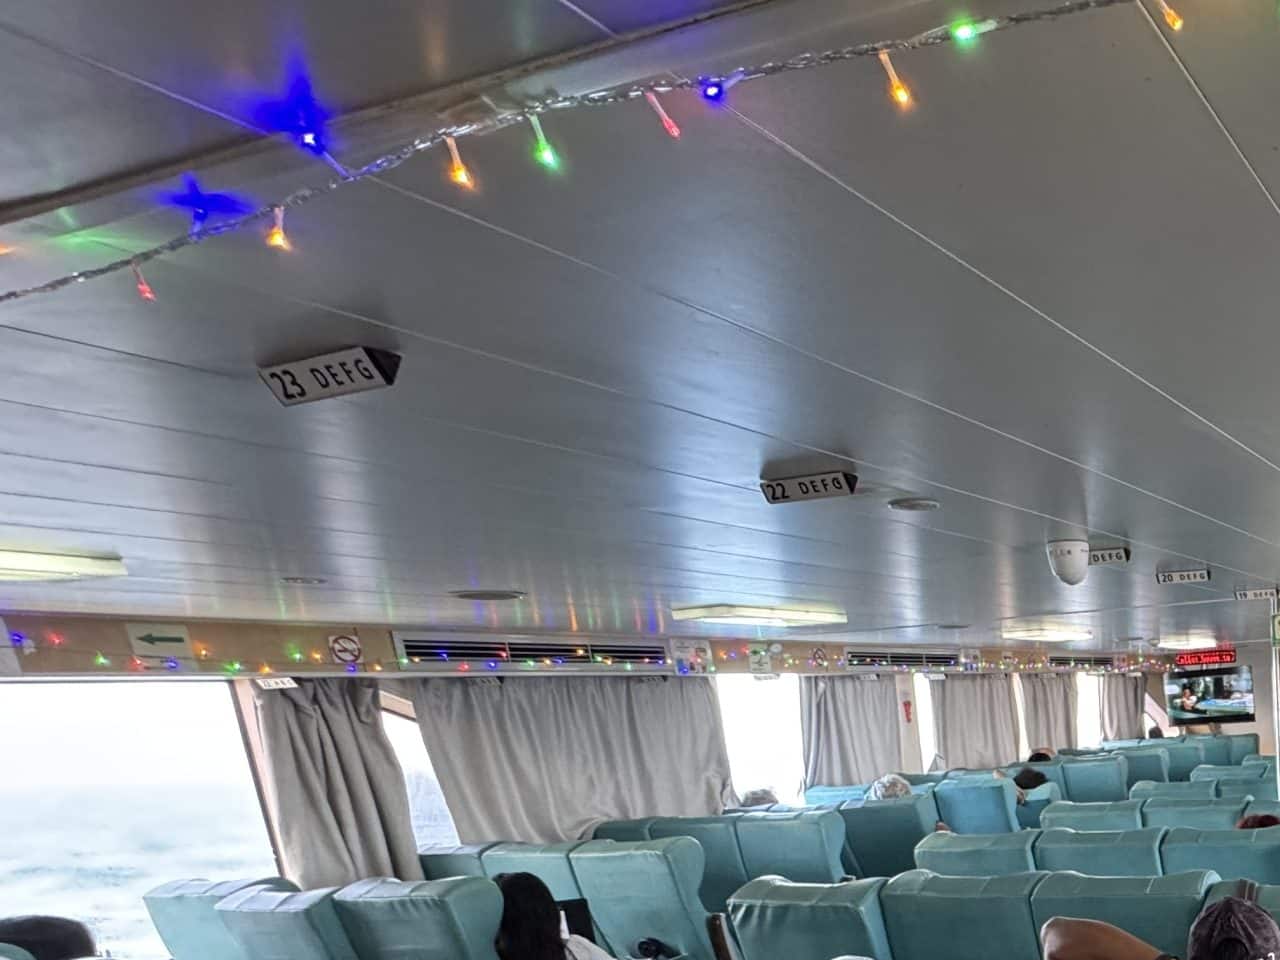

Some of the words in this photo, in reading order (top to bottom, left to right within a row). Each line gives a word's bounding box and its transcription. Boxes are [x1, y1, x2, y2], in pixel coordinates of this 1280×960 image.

[269, 370, 306, 399] 23
[309, 359, 375, 389] DEFG
[766, 482, 790, 500] 22
[798, 477, 843, 494] DEFG
[1093, 552, 1122, 562] DEFG
[1162, 574, 1173, 582] 20
[1180, 572, 1205, 581] DEFG
